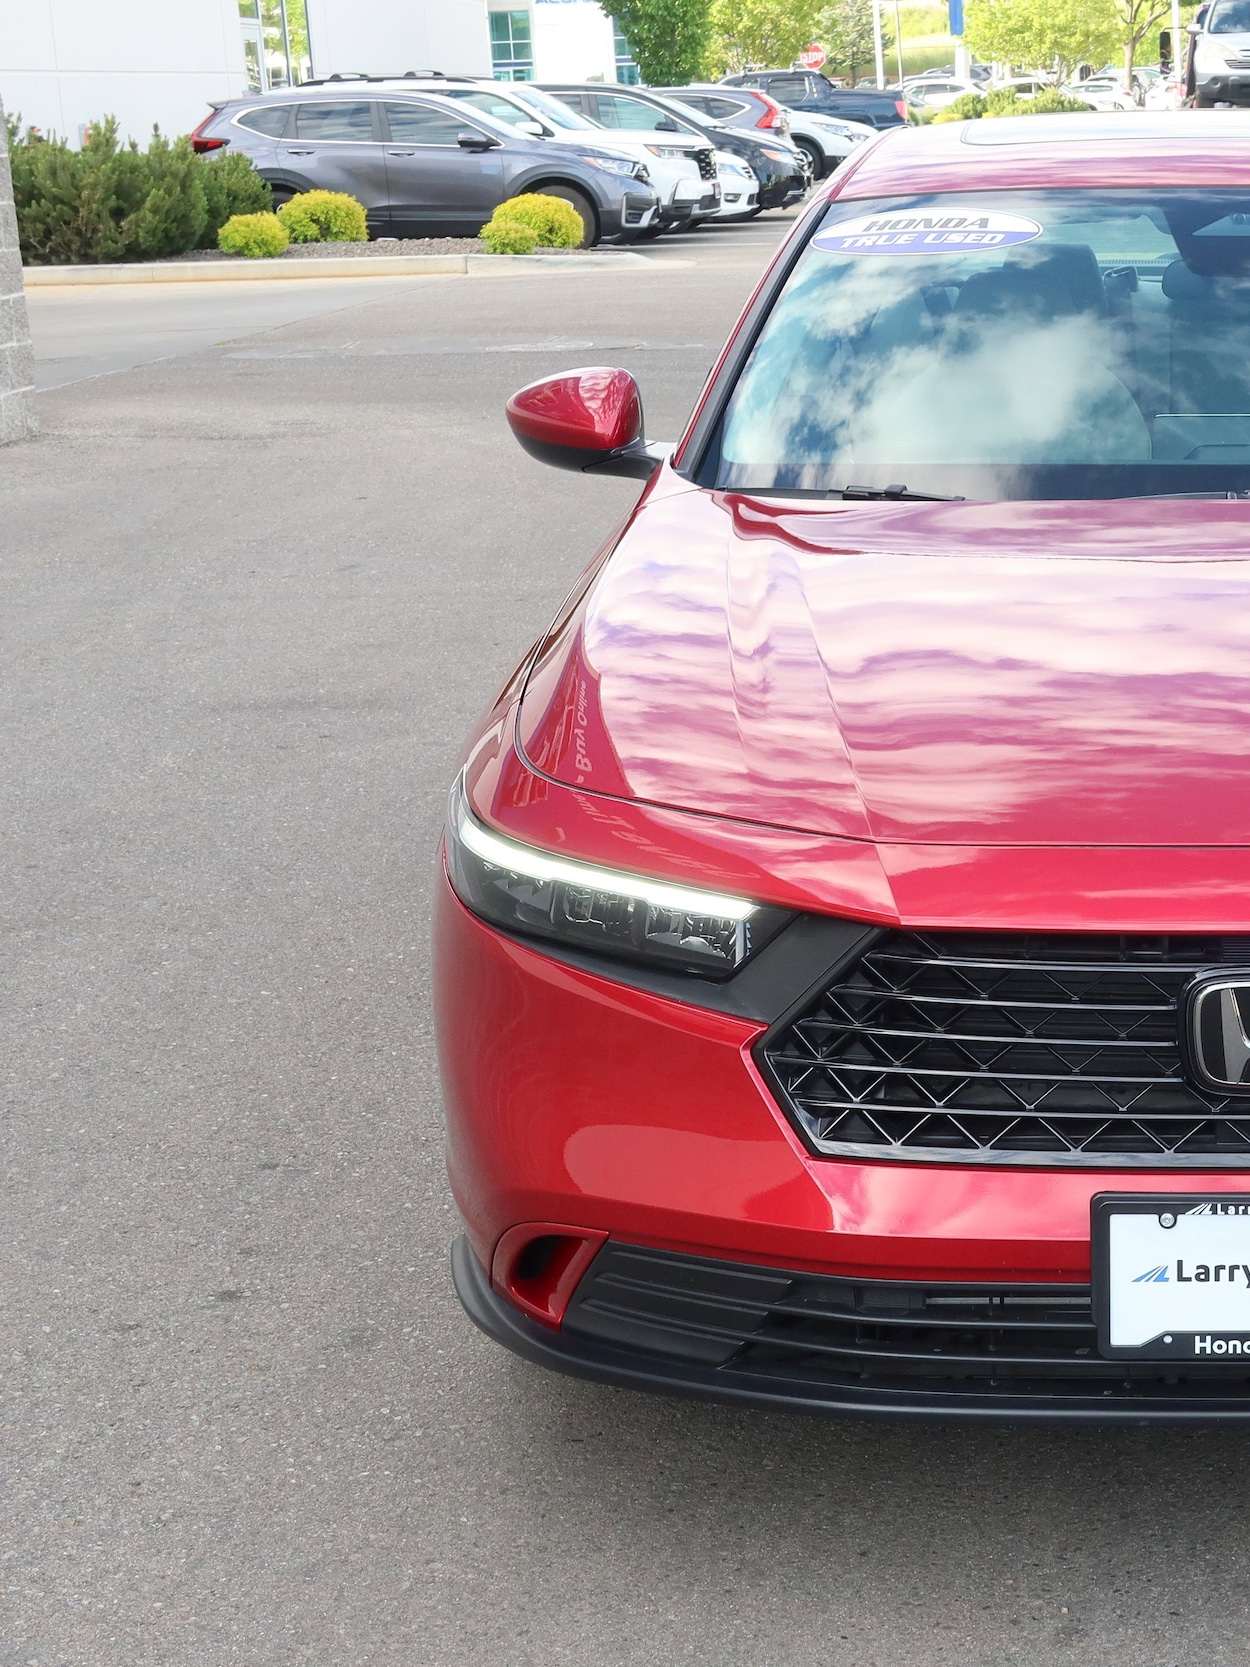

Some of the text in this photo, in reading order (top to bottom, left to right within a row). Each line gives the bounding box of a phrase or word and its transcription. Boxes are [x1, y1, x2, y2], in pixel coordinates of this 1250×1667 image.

[802, 52, 823, 62] STOP
[862, 217, 989, 232] HONDA
[840, 233, 1005, 248] TRUE USED
